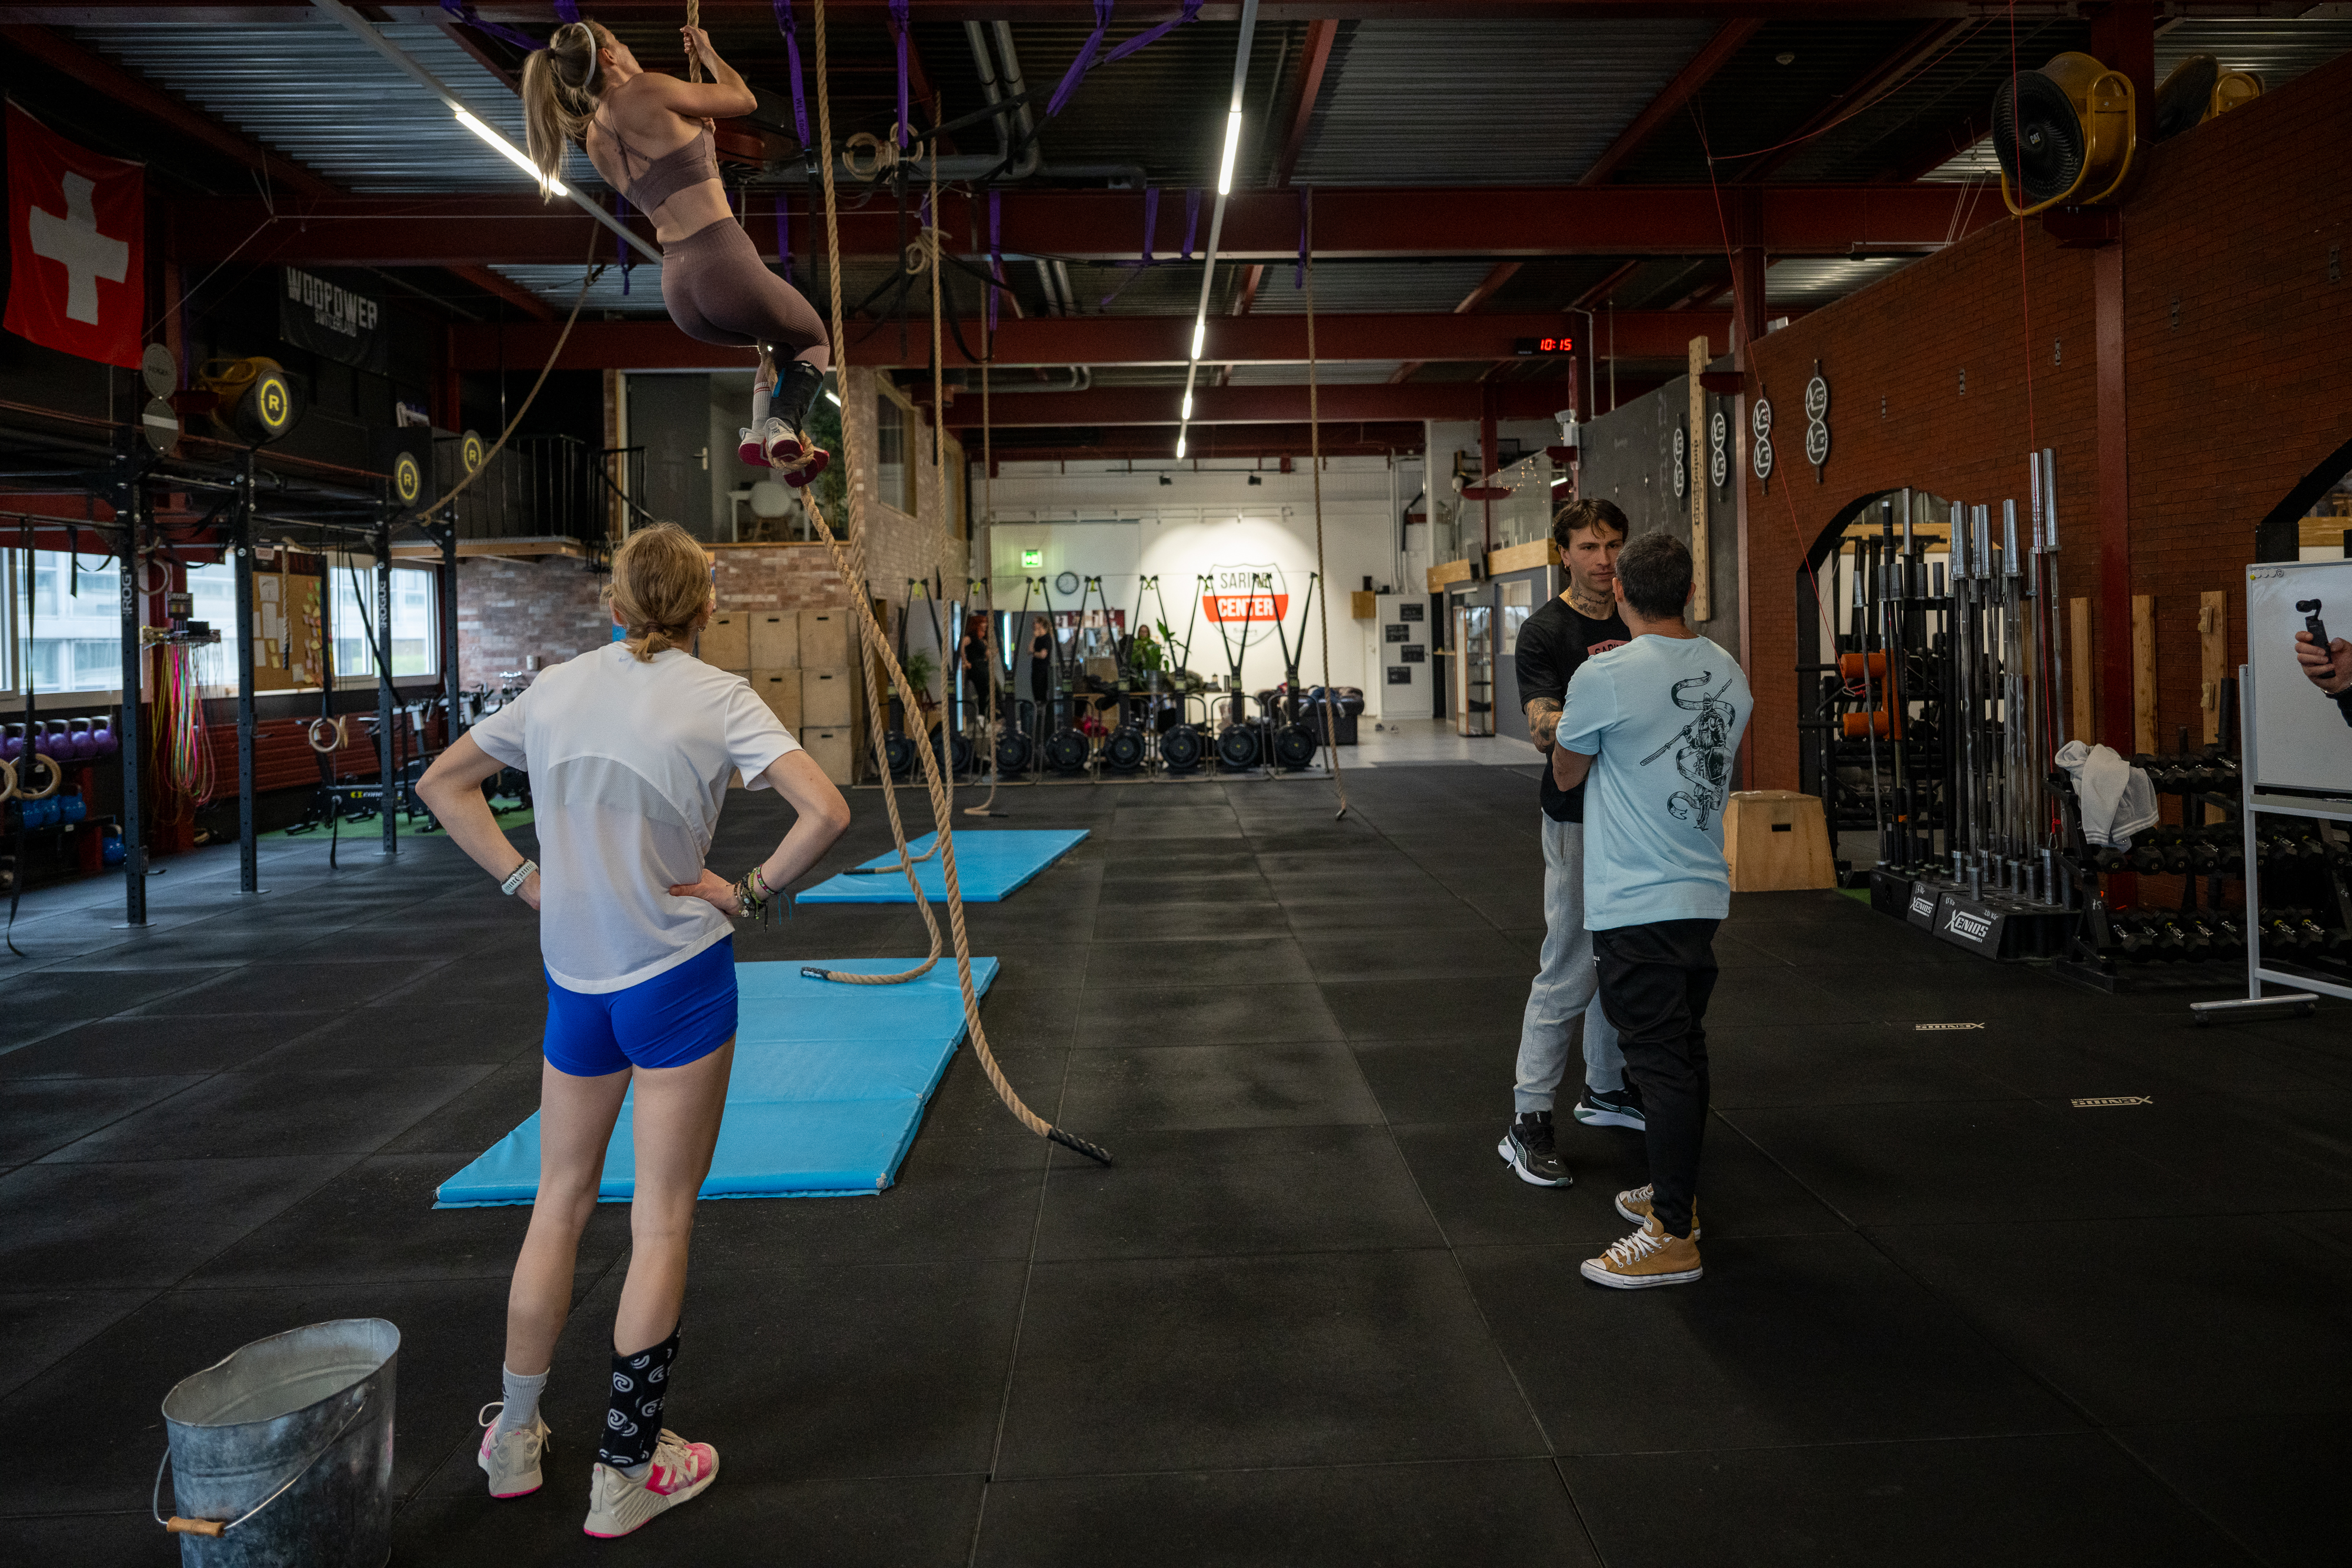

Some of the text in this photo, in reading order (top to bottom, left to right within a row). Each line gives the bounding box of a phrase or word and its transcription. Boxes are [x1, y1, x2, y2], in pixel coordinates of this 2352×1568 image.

[2030, 132, 2040, 144] CAT
[1540, 338, 1572, 351] 10:15
[269, 394, 279, 411] R
[469, 449, 477, 462] R
[404, 473, 412, 486] R
[1217, 597, 1274, 617] CENTER
[1909, 897, 1934, 917] XENIOS
[1944, 910, 1992, 941] XENIOS
